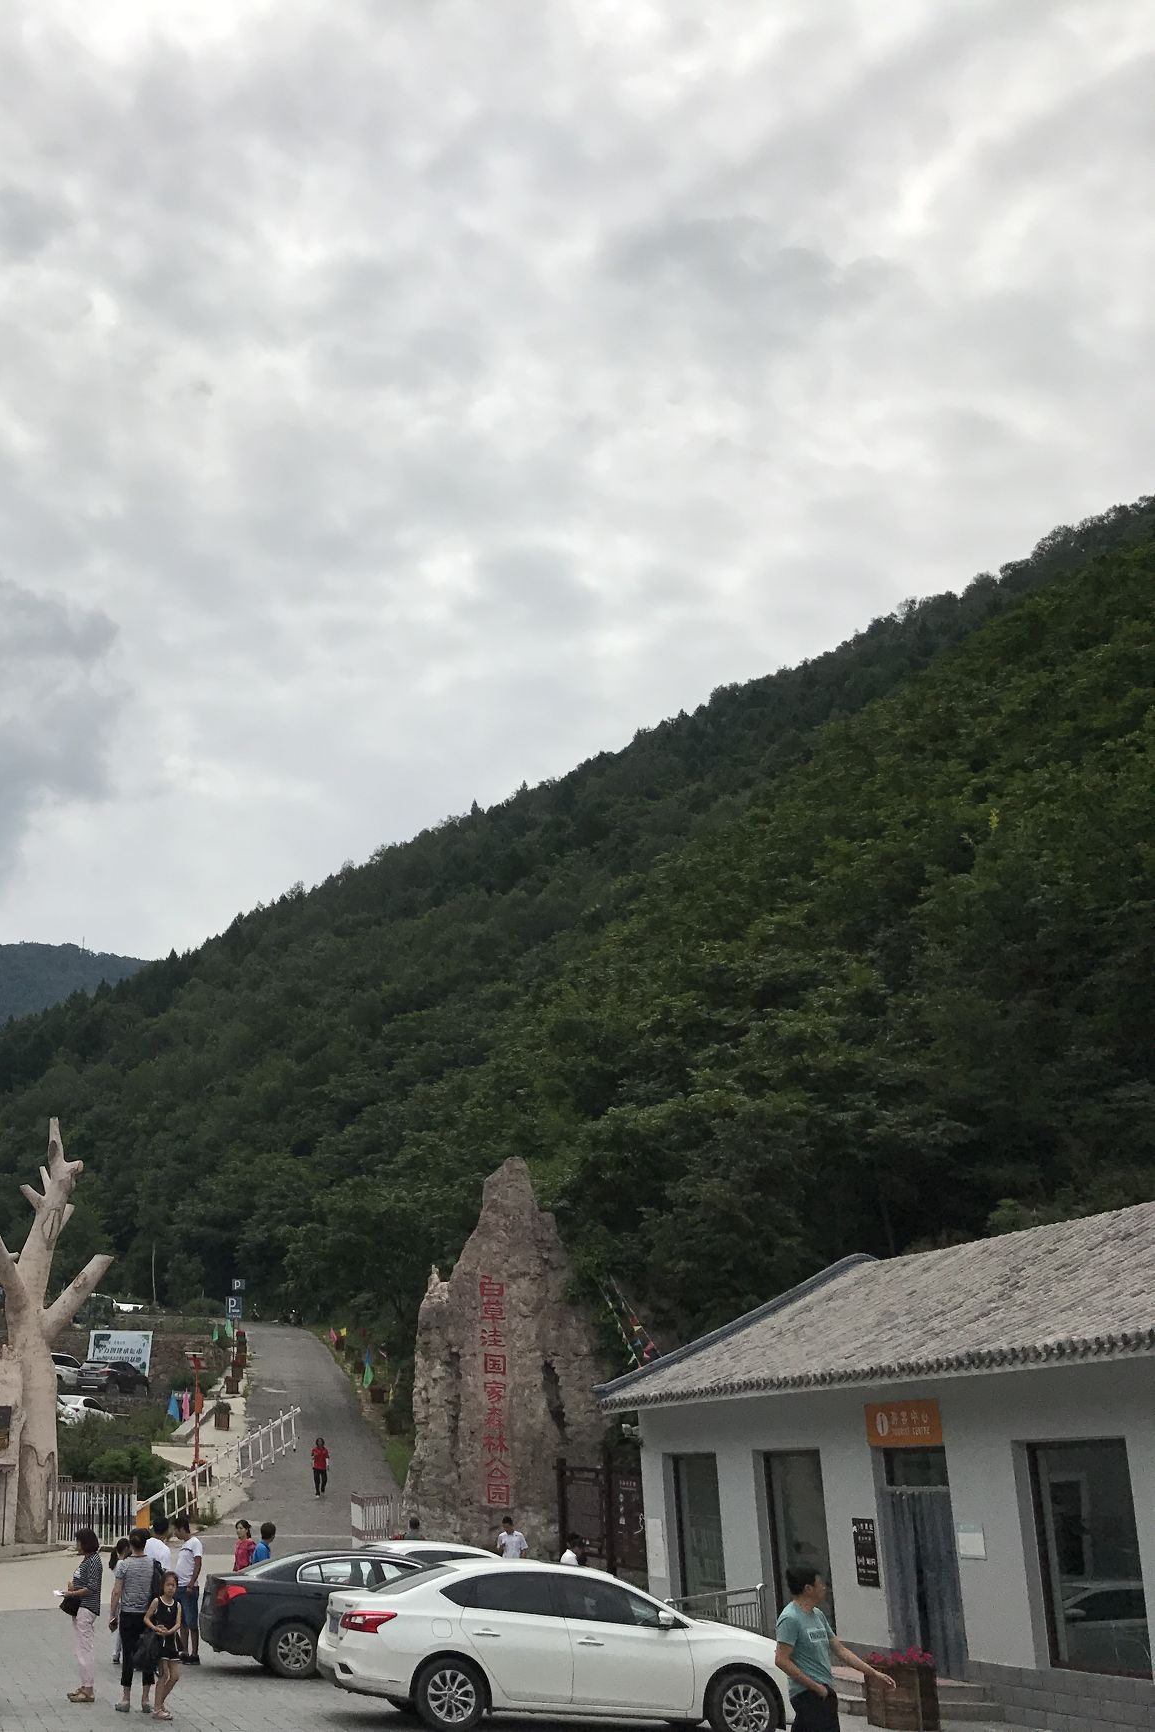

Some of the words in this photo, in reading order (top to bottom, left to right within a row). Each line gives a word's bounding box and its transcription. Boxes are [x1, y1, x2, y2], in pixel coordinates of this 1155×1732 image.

[229, 1297, 237, 1314] P
[479, 1274, 511, 1505] 白草洼国家森林公园
